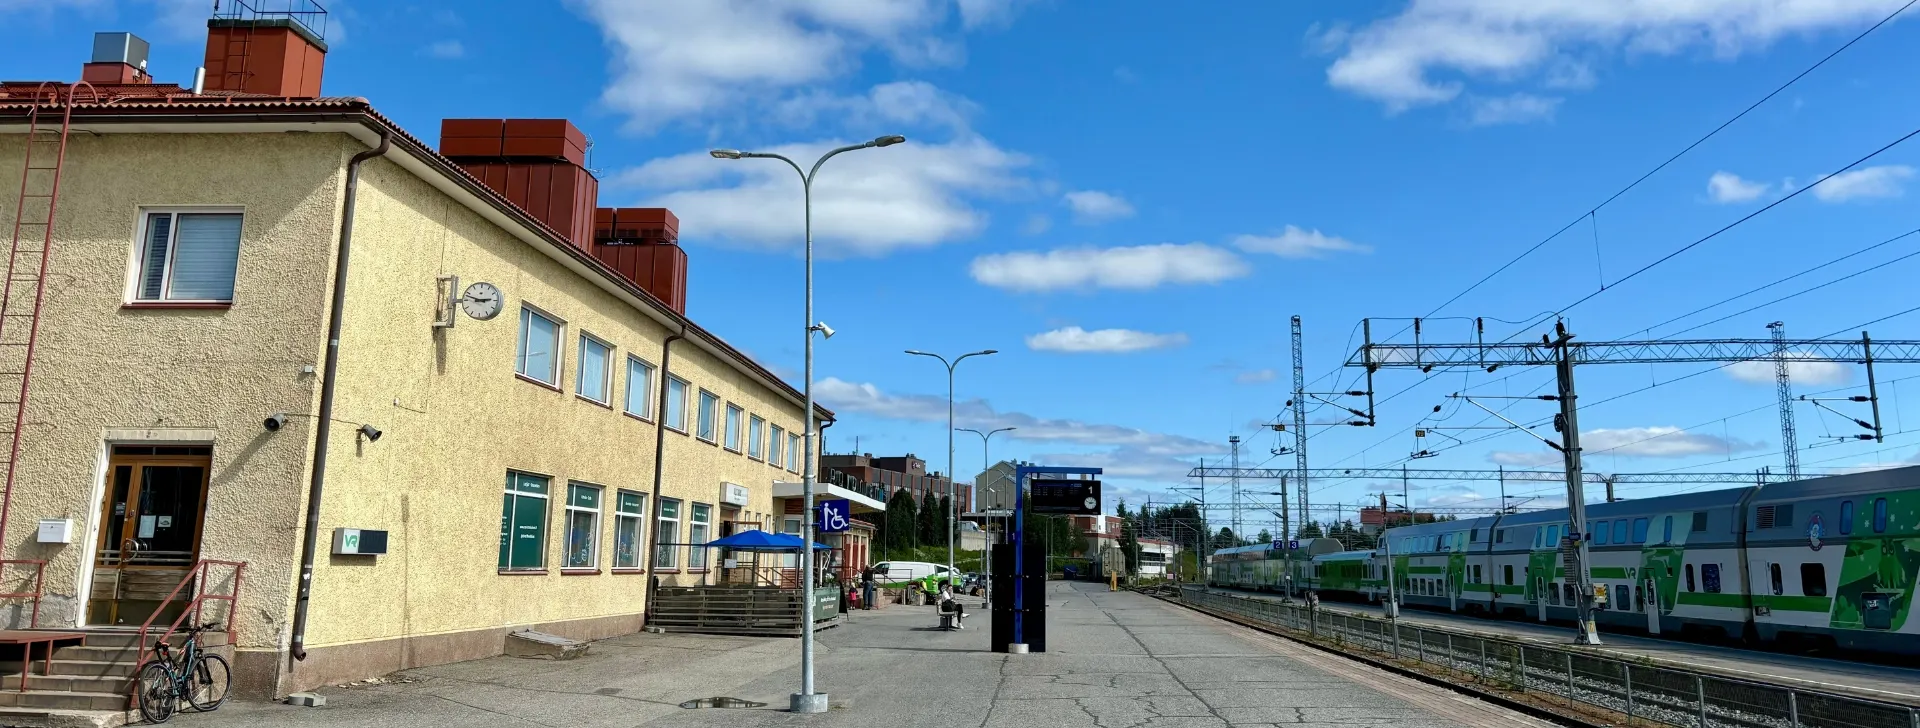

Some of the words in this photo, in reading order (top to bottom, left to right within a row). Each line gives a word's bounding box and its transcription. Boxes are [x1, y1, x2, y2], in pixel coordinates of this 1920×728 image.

[1088, 485, 1093, 494] 1
[1011, 532, 1016, 540] 1
[344, 534, 358, 548] VR
[1275, 541, 1281, 549] 2
[1291, 541, 1297, 549] 3
[1625, 567, 1636, 580] VR
